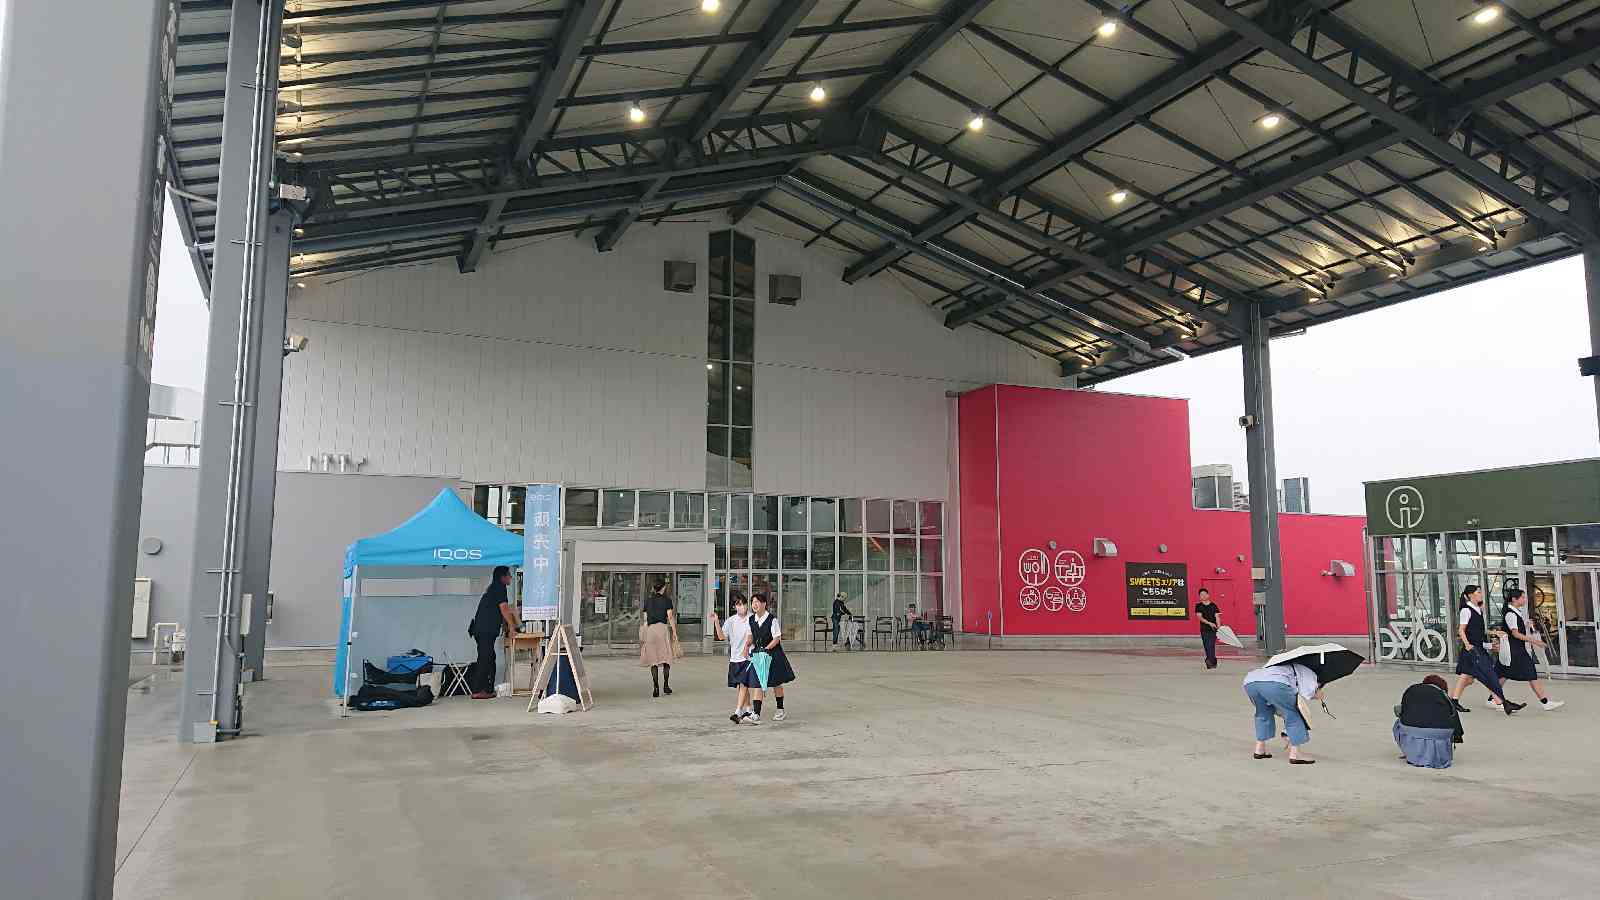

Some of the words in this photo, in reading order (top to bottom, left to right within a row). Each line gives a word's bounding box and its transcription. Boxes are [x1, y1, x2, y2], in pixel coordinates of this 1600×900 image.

[433, 548, 482, 561] IQOS
[1142, 588, 1173, 596] こちらから
